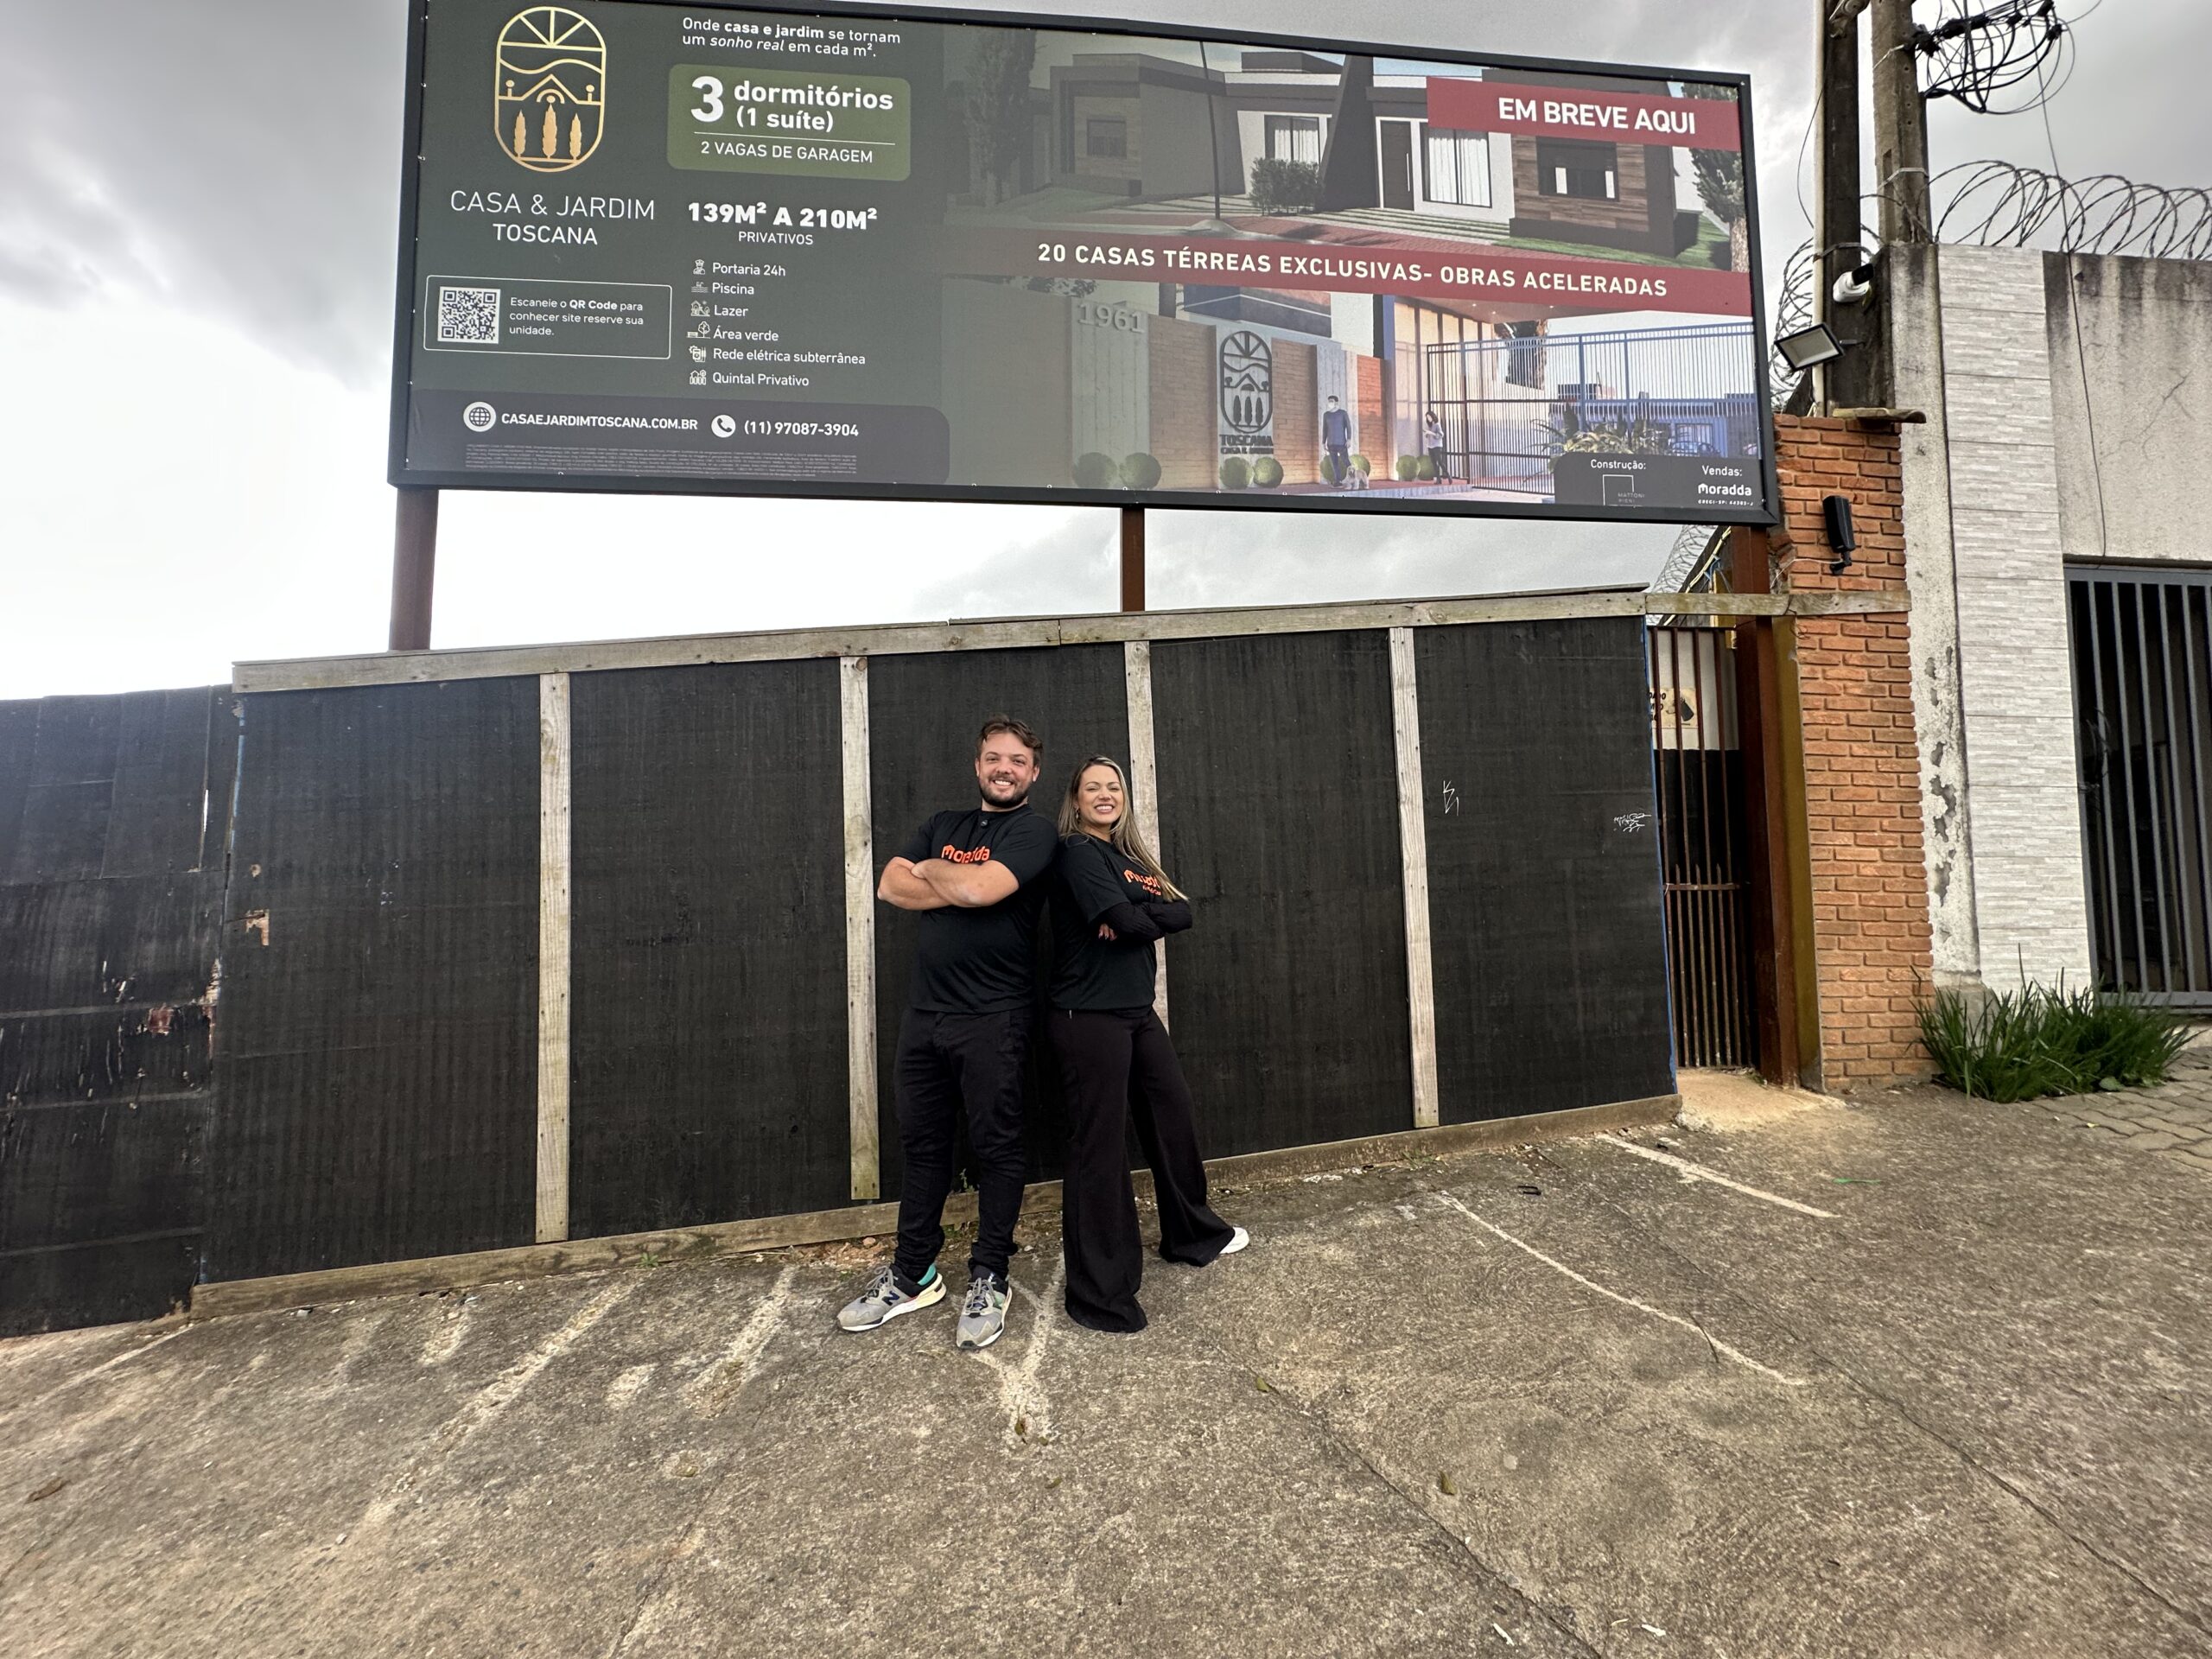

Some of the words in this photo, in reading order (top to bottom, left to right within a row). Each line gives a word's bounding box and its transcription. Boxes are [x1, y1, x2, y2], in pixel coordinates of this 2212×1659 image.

[683, 16, 721, 32] Onde
[724, 22, 760, 35] casa
[763, 25, 772, 35] e
[775, 23, 824, 41] jardim
[828, 30, 845, 41] se
[849, 31, 901, 44] tornam
[682, 36, 706, 47] um
[709, 35, 753, 49] sonho
[756, 40, 785, 53] real
[788, 42, 810, 54] em
[815, 42, 849, 56] cada
[690, 75, 724, 123] 3
[734, 79, 894, 111] dormitórios
[735, 108, 758, 130] (1
[766, 110, 834, 133] suíte)
[1497, 97, 1537, 122] EM
[1542, 100, 1629, 130] BREVE
[1633, 108, 1695, 135] AQUI
[701, 141, 710, 155] 2
[714, 141, 767, 157] VAGAS
[772, 144, 792, 159] DE
[797, 146, 873, 163] GARAGEM
[450, 190, 522, 214] CASA
[531, 194, 548, 215] &
[556, 195, 654, 220] JARDIM
[772, 207, 793, 226] A
[492, 223, 598, 245] TOSCANA
[738, 231, 814, 245] PRIVATIVOS
[712, 262, 760, 276] Portaria
[763, 264, 786, 276] 24h
[1037, 243, 1066, 263] 20
[1074, 245, 1155, 267] CASAS
[1162, 245, 1272, 273] TÉRREAS
[1440, 266, 1516, 288] OBRAS
[1522, 272, 1668, 297] ACELERADAS
[712, 282, 754, 296] Piscina
[510, 296, 558, 308] Escaneie
[569, 299, 586, 309] QR
[588, 300, 618, 310] Code
[620, 302, 644, 313] para
[714, 304, 749, 317] Lazer
[509, 312, 560, 322] conhecer
[562, 313, 582, 323] site
[583, 315, 623, 324] reserve
[1077, 303, 1146, 334] 1961
[509, 325, 555, 336] unidade.
[713, 325, 742, 340] Área
[744, 330, 779, 341] verde
[713, 347, 744, 360] Rede
[746, 349, 791, 362] elétrica
[793, 351, 866, 365] subterrânea
[712, 372, 755, 385] Quintal
[757, 373, 810, 386] Privativo
[501, 413, 698, 430] CASAEJARDIMTOSCANA.COM.BR
[744, 420, 772, 435] (11)
[774, 422, 859, 436] 97087-3904
[1590, 459, 1647, 471] Construção:
[1701, 465, 1743, 477] Vendas:
